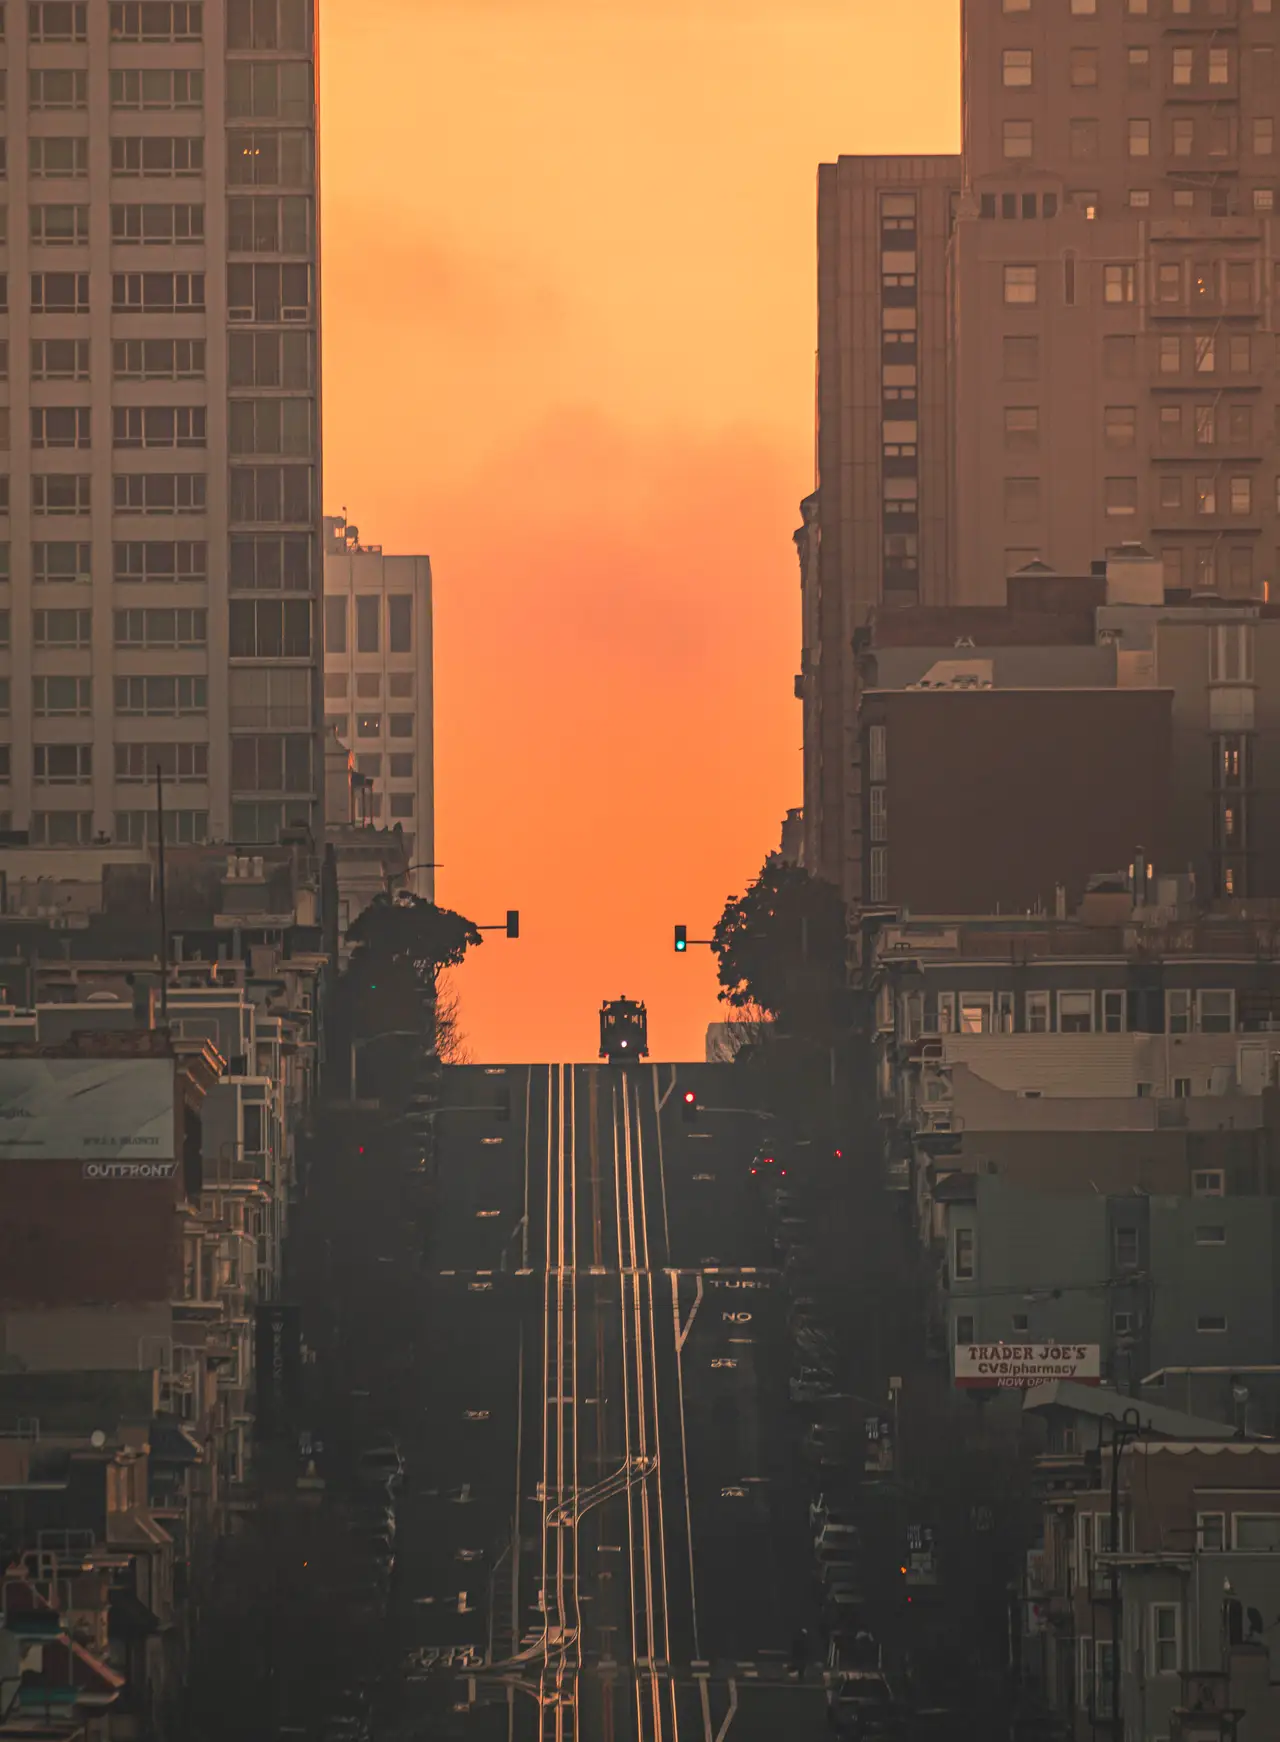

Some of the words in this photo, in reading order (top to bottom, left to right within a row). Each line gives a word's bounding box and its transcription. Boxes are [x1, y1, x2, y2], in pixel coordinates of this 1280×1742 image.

[722, 1312, 752, 1321] NO
[969, 1346, 1033, 1360] TRADER
[1039, 1346, 1087, 1360] JOE'S
[978, 1362, 1077, 1376] CVS/pharmacy
[997, 1377, 1025, 1387] NOW
